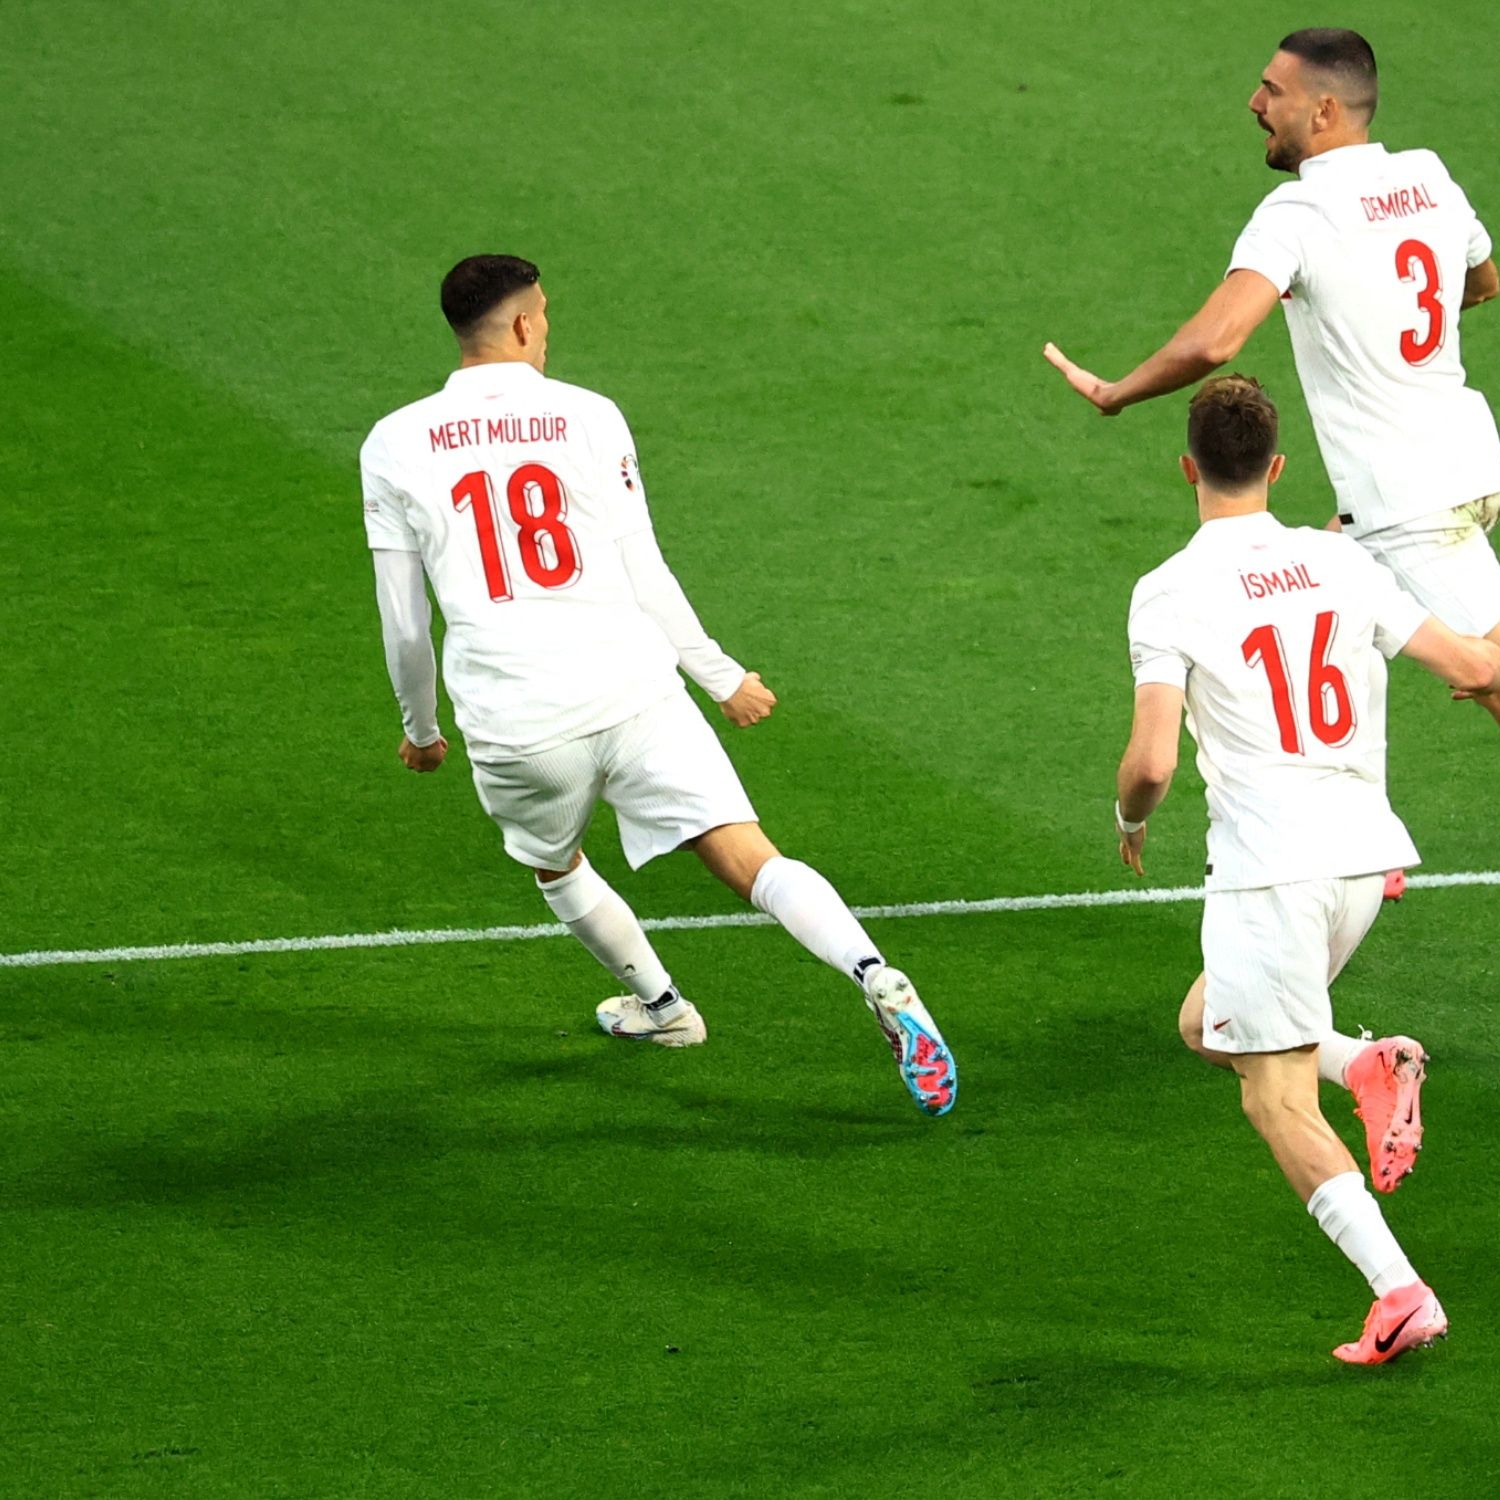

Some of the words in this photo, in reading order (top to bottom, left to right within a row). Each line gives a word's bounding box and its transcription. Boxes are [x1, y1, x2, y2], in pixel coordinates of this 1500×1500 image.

[1360, 183, 1438, 222] DEMİRAL
[1395, 239, 1446, 367] 3
[429, 418, 481, 453] MERT
[487, 412, 567, 444] MÜLDÜR
[451, 460, 582, 603] 18
[1237, 560, 1320, 600] İSMAİL
[1241, 610, 1357, 756] 16
